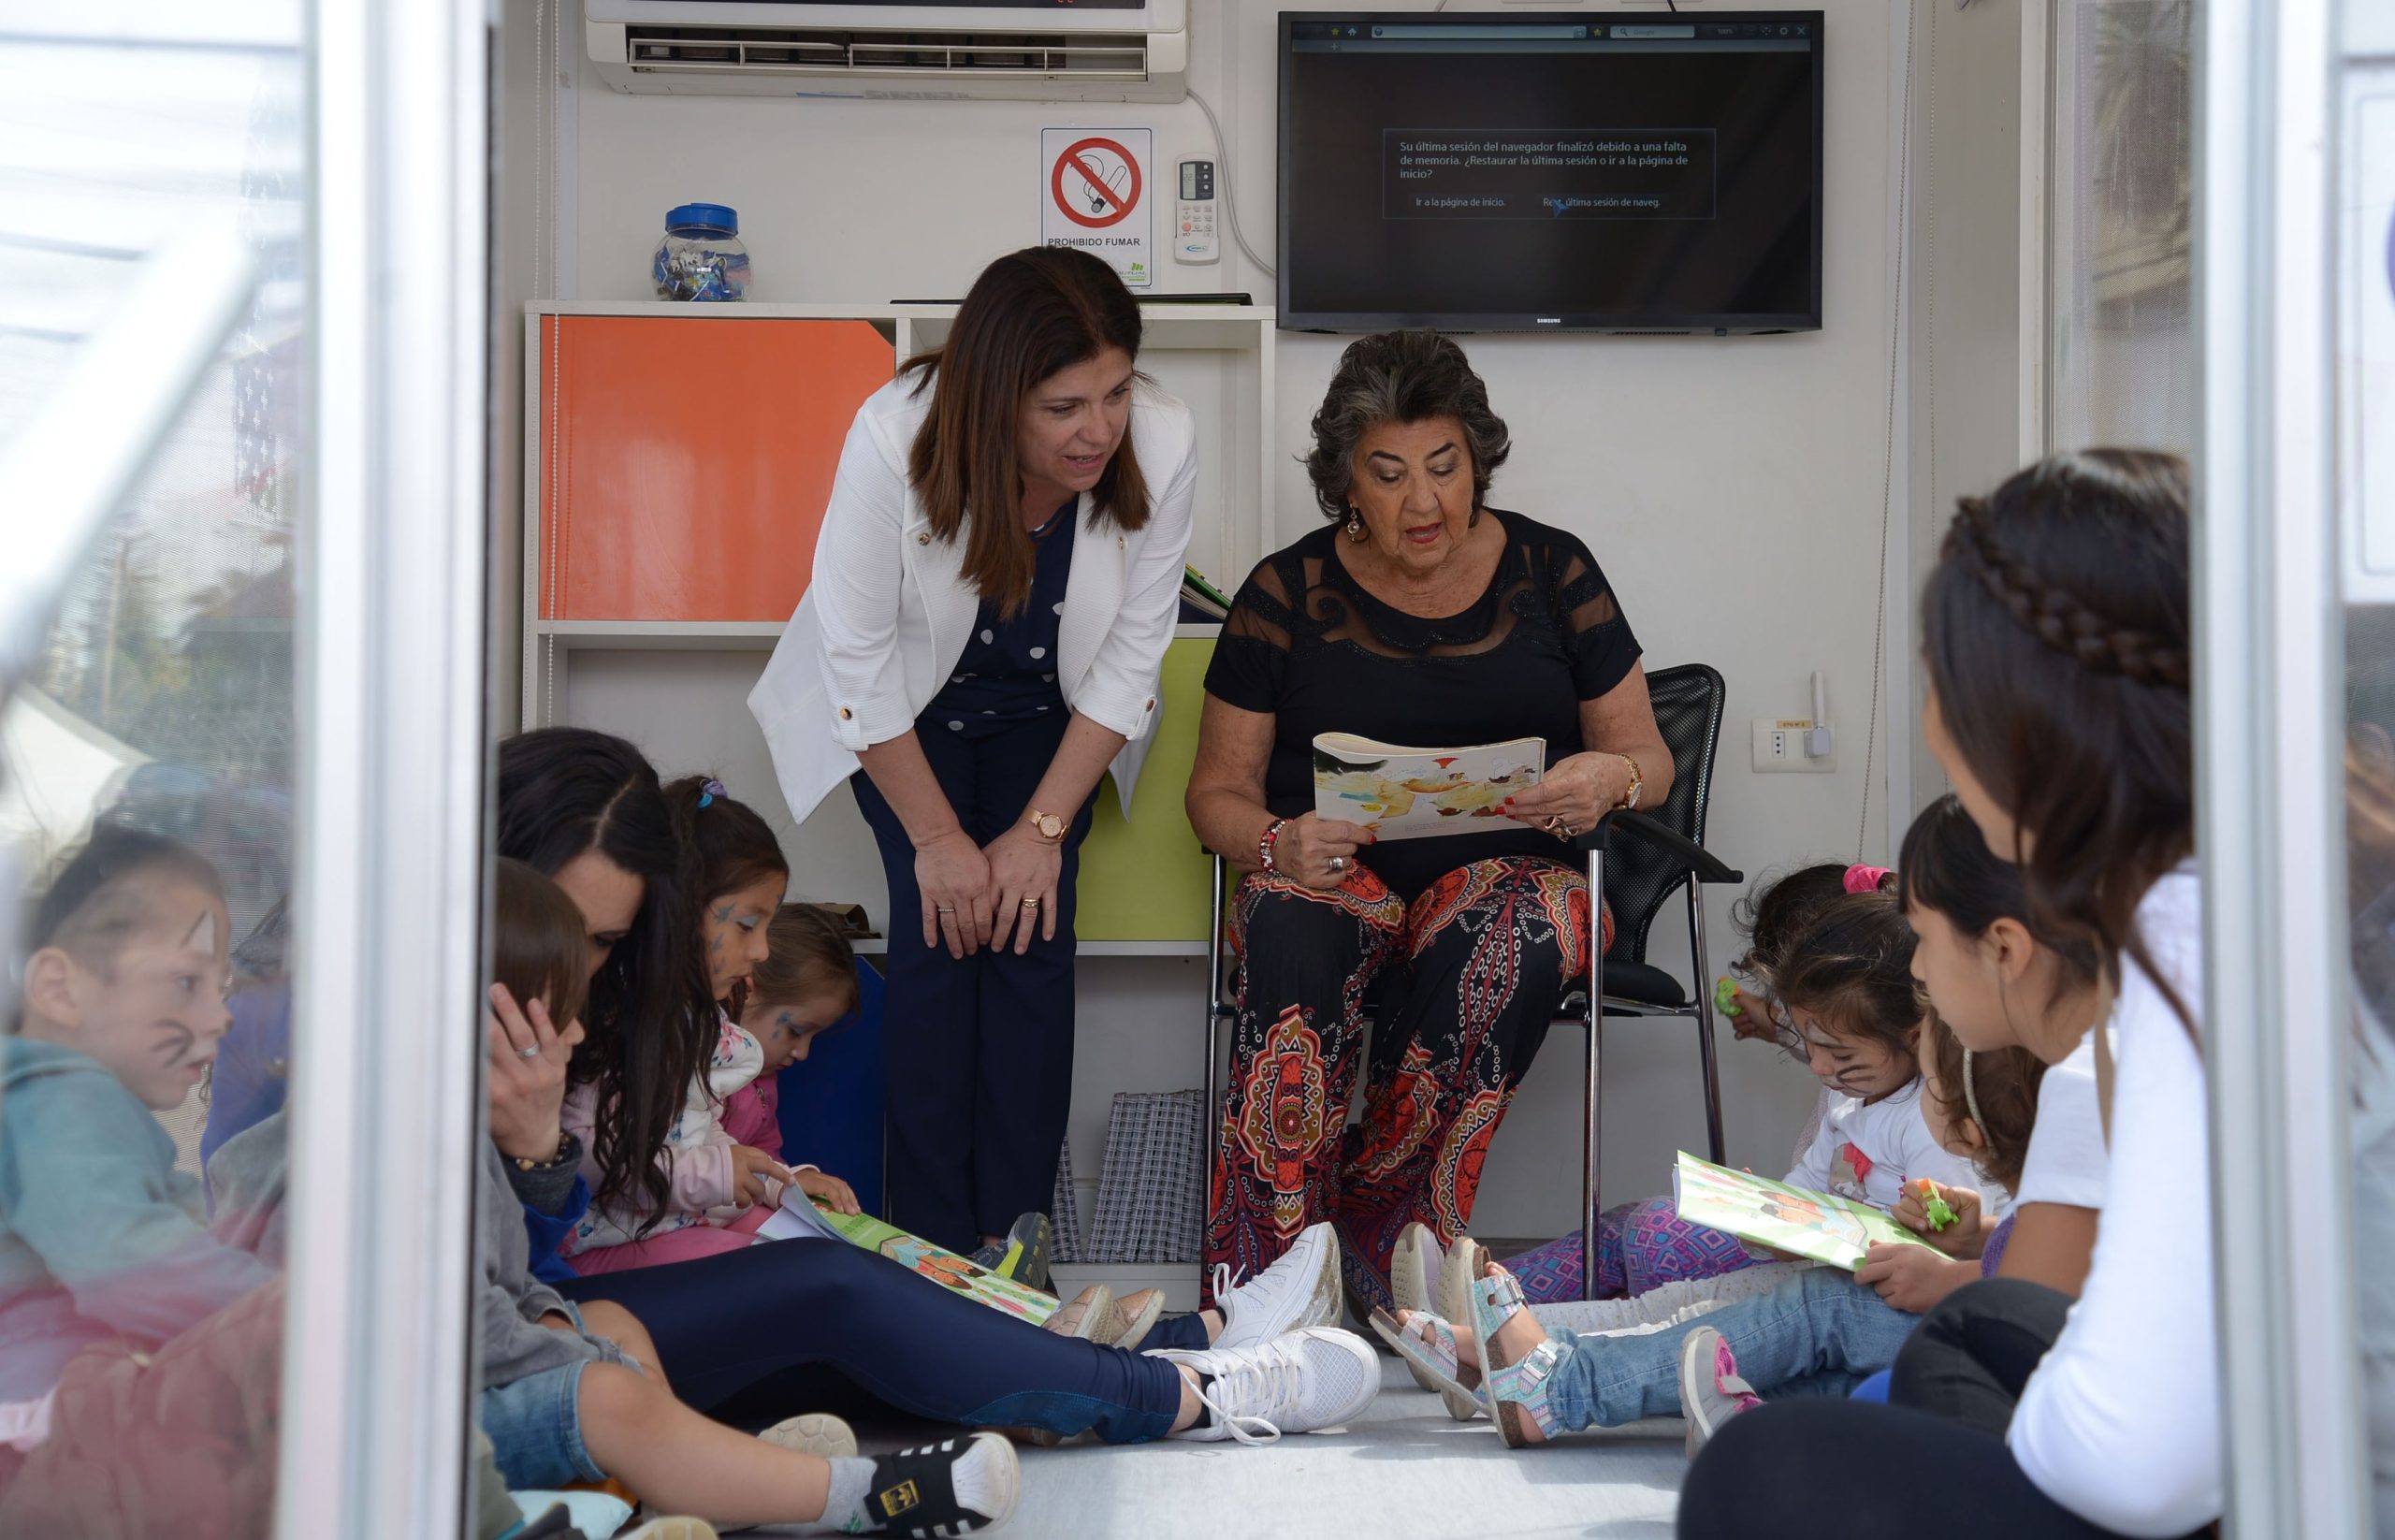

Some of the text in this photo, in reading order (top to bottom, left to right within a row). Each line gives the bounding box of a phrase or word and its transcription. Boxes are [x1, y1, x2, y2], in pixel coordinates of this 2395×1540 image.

[1400, 142, 1414, 152] Su
[1415, 141, 1447, 152] última
[1449, 141, 1481, 152] sesión
[1483, 141, 1499, 152] del
[1501, 141, 1555, 153] navegador
[1557, 141, 1594, 152] finalizó
[1596, 141, 1632, 152] debido
[1663, 141, 1687, 152] falta
[1400, 155, 1689, 167] de memoria. ¿Restaurar la última sesión o ir a la página de
[1400, 168, 1433, 179] inicio?
[1415, 197, 1422, 207] Ir
[1431, 197, 1439, 207] la
[1440, 197, 1469, 208] página
[1470, 197, 1481, 207] de
[1565, 196, 1591, 208] última
[1592, 197, 1619, 208] sesión
[1620, 197, 1632, 208] de
[1633, 197, 1661, 208] naveg.
[1048, 238, 1140, 246] PROHIBIDO FUMAR
